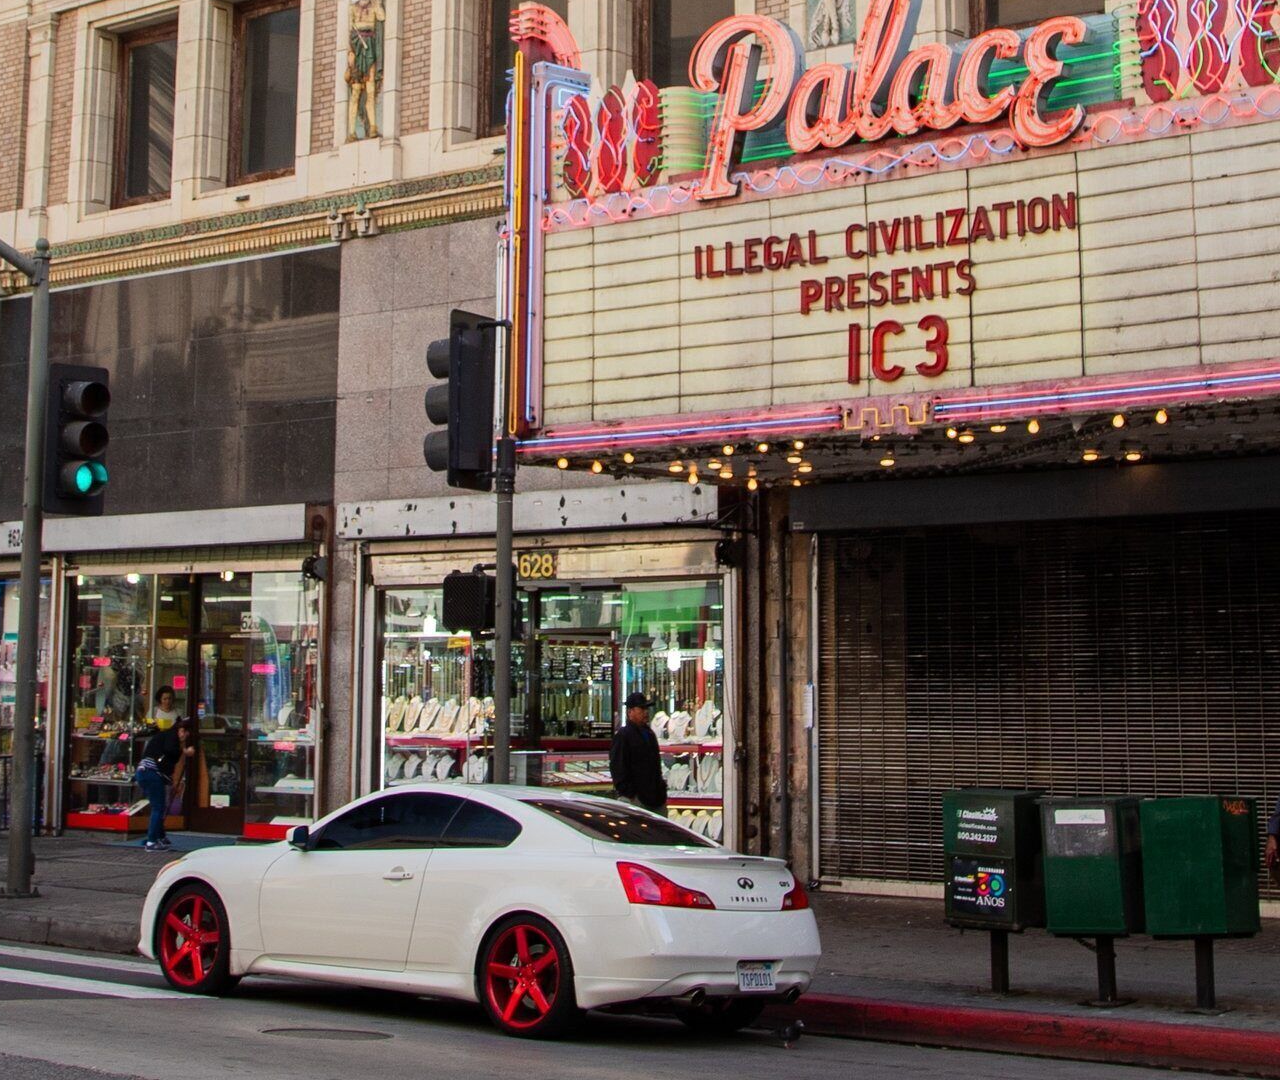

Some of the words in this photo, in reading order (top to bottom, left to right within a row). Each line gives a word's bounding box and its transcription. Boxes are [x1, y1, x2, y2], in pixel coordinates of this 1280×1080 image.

[694, 229, 829, 280] ILLEGAL
[844, 191, 1078, 261] CIVILIZATION
[800, 258, 977, 315] PRESENTS
[847, 314, 950, 385] IC3
[7, 529, 24, 548] #62
[520, 553, 554, 578] 628
[977, 873, 1006, 896] 30
[976, 894, 1006, 908] AÑOS
